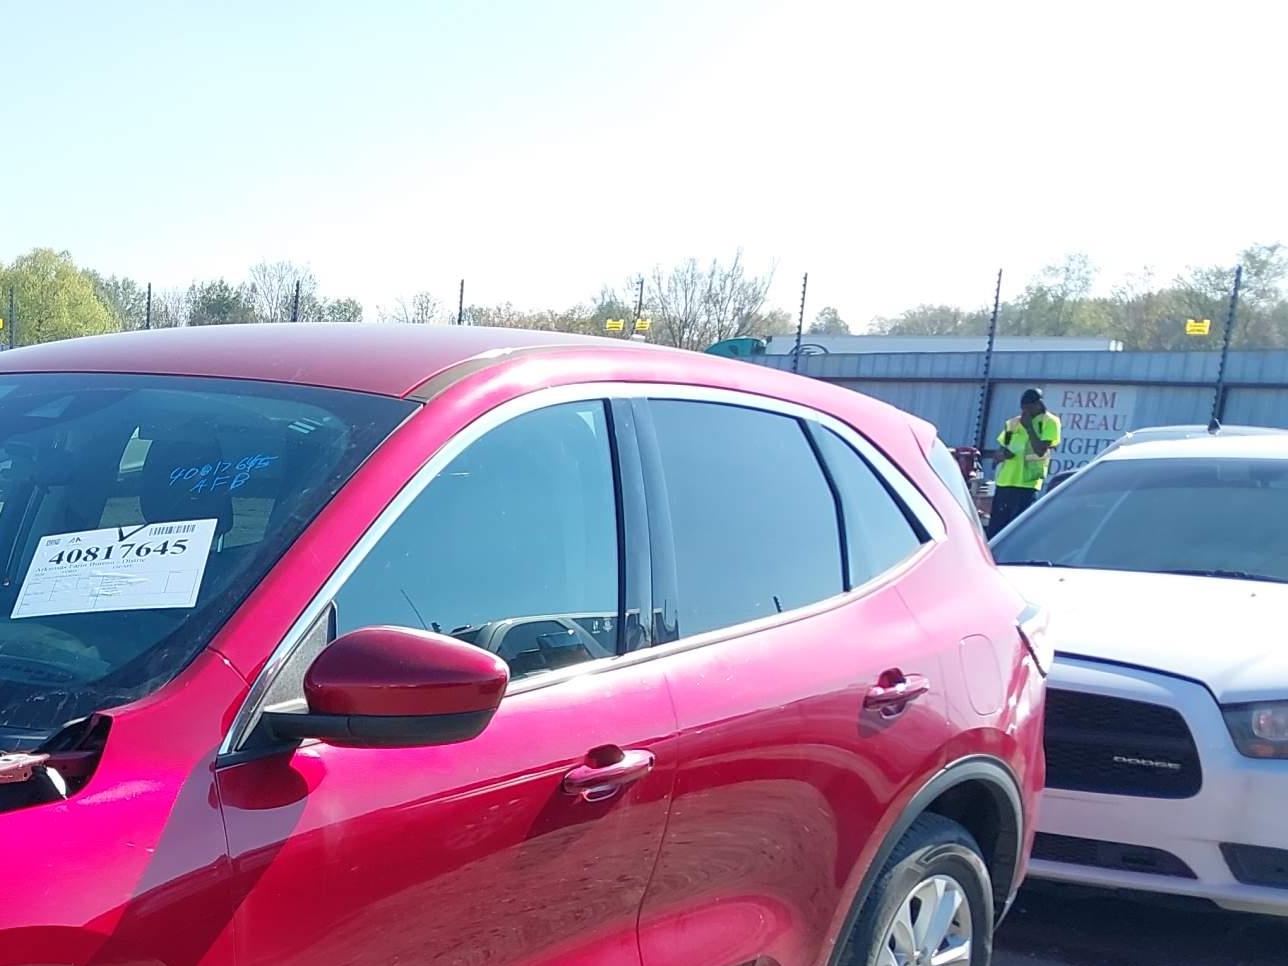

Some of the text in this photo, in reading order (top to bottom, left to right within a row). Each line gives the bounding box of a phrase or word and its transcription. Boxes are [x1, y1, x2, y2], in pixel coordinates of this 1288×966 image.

[1061, 390, 1117, 409] FARM
[1057, 412, 1129, 432] UREAU
[1052, 437, 1116, 455] IGHT
[48, 538, 190, 565] 40817645
[1113, 755, 1182, 770] DODGE
